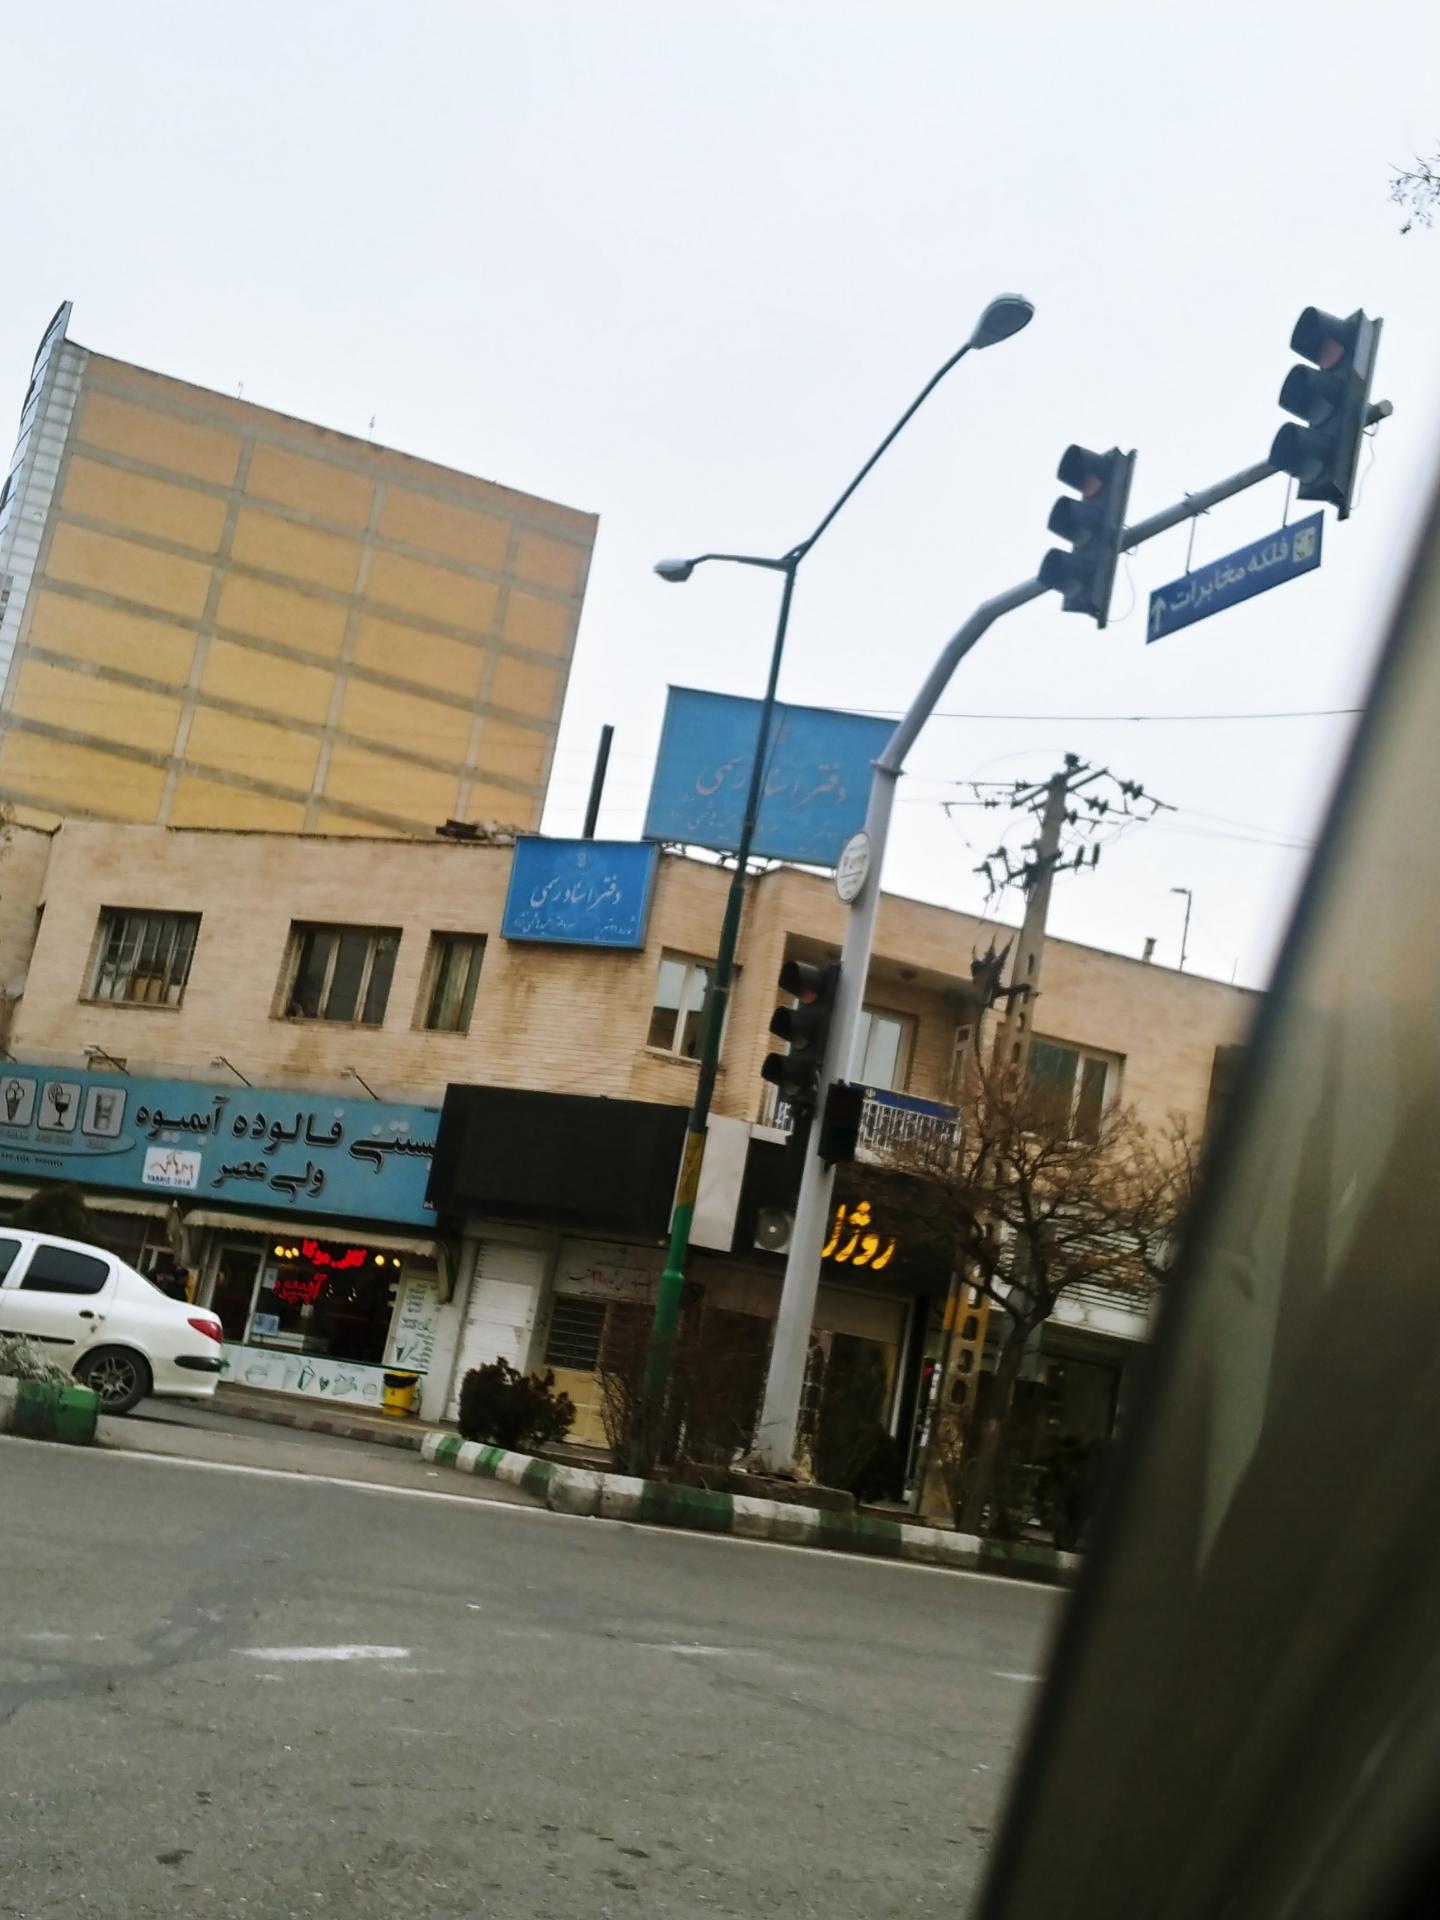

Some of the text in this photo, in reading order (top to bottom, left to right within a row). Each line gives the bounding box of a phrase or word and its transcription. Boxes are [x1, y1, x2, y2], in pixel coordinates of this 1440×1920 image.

[1169, 536, 1289, 612] فلکه مخابرات
[529, 875, 563, 909] رسمی
[586, 874, 623, 913] دفتر
[133, 1094, 437, 1175] ستنی فالوده آبمیوه
[208, 1159, 326, 1204] ولی عصر
